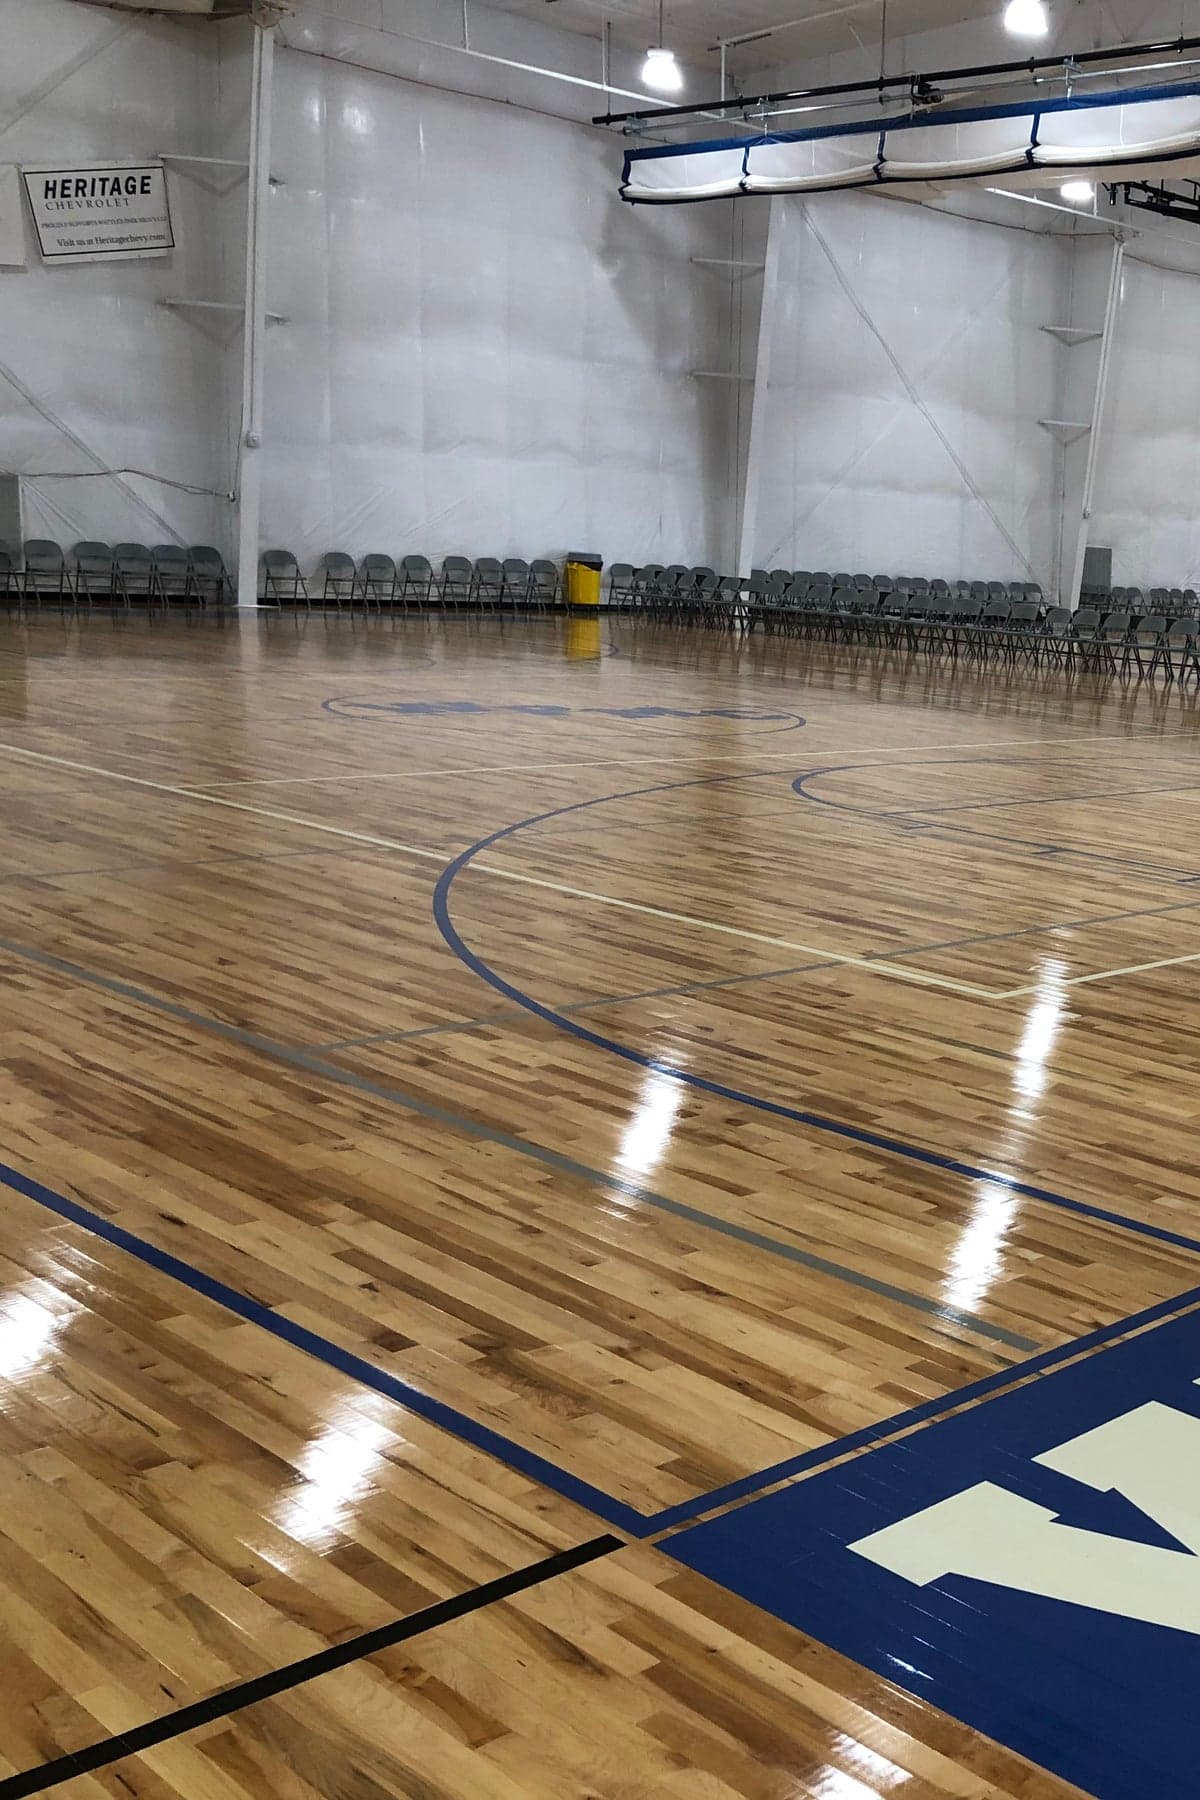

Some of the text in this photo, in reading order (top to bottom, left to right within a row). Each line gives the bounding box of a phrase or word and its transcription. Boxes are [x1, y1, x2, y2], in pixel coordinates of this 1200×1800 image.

[44, 175, 152, 200] HERITAGE
[45, 197, 130, 211] CHEVROLET
[57, 238, 75, 247] Visit
